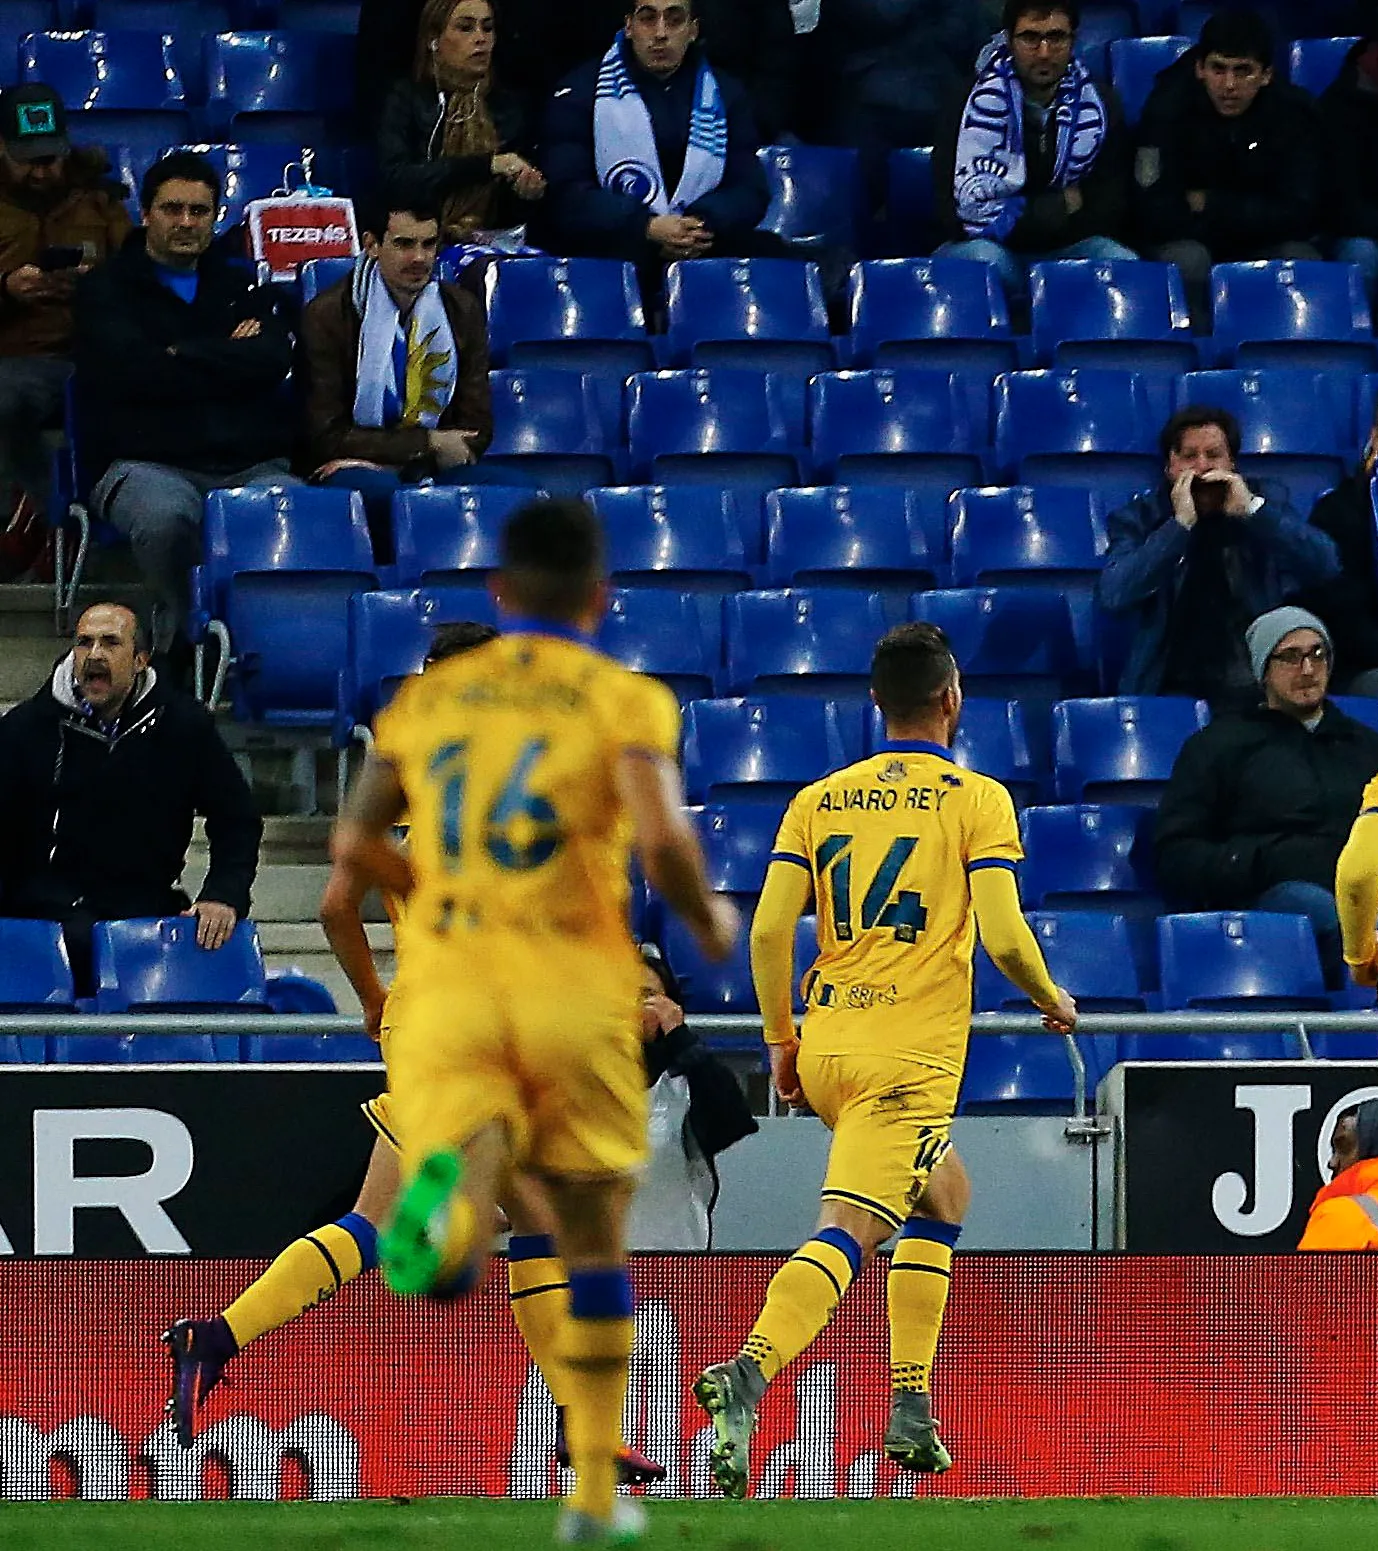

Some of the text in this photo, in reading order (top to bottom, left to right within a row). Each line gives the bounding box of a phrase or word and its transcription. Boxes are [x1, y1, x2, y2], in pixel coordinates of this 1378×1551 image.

[428, 738, 560, 874] 16
[816, 787, 948, 812] ALVARO REY
[816, 834, 928, 944] 14
[0, 1108, 193, 1255] R
